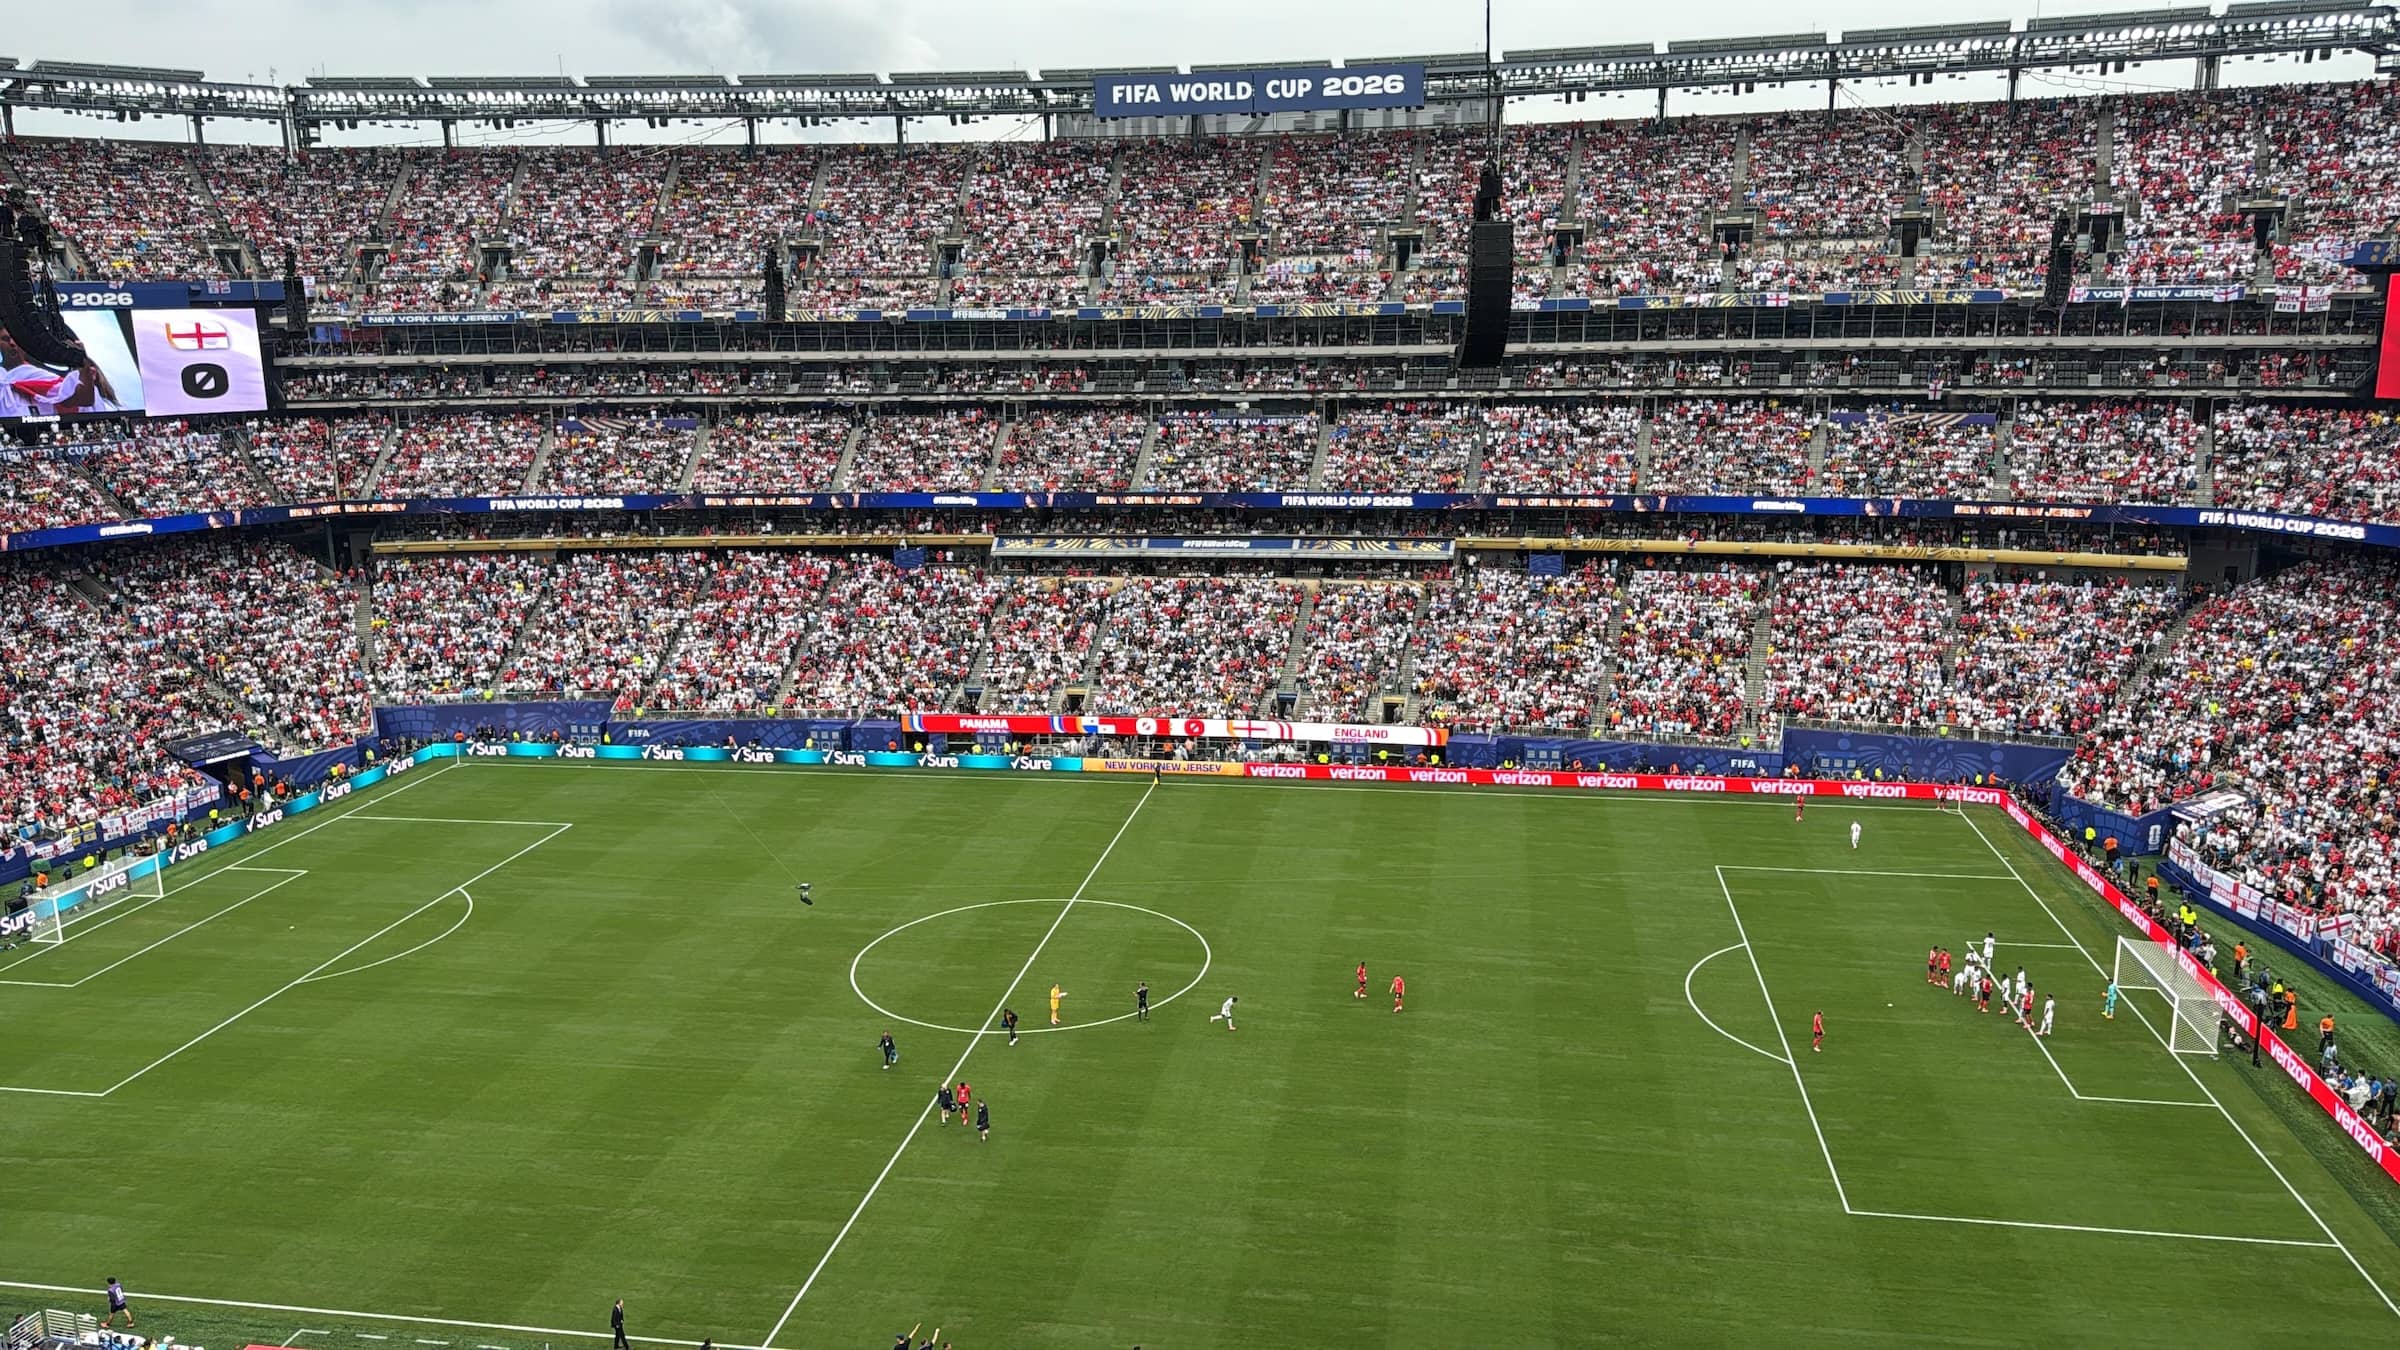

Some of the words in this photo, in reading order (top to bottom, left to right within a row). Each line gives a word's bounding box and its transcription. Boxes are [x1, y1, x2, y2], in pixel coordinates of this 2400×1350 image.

[1112, 84, 1161, 104] FIFA
[1169, 81, 1252, 102] WORLD
[1265, 78, 1313, 99] CUP
[1322, 74, 1405, 96] 2026
[71, 292, 134, 307] 2026
[2136, 289, 2171, 298] NEW
[2173, 288, 2214, 298] JERS
[368, 316, 395, 324] NEW
[398, 315, 430, 323] YORK
[432, 315, 460, 323] NEW
[462, 314, 508, 322] JERSEY
[181, 362, 229, 399] 0
[490, 500, 515, 510] FIFA
[516, 499, 558, 510] WORLD
[558, 498, 582, 509] CUP
[704, 497, 727, 506] NEW
[727, 497, 754, 506] YORK
[754, 497, 776, 506] NEW
[776, 497, 813, 506] JERSEY
[1096, 496, 1117, 505] NEW
[1118, 496, 1144, 505] YORK
[1144, 496, 1166, 505] NEW
[1166, 496, 1202, 505] JERSEY
[1281, 495, 1307, 506] FIFA
[1307, 495, 1348, 506] WORLD
[1348, 496, 1372, 507] CUP
[1496, 497, 1520, 507] NEW
[1521, 498, 1548, 507] YORK
[1549, 498, 1573, 507] NEW
[1573, 498, 1614, 508] JERSEY
[289, 508, 313, 517] NEW
[314, 505, 342, 515] YORK
[344, 504, 368, 513] NEW
[368, 502, 406, 512] JERSEY
[1953, 504, 1980, 515] NEW
[1982, 505, 2015, 516] YORK
[2015, 506, 2044, 517] NEW
[2044, 508, 2092, 519] JERSEY
[2199, 511, 2235, 525] FIFA
[2236, 513, 2284, 530] WORLD
[2285, 519, 2314, 534] CUP
[959, 718, 1009, 730] PANAMA
[628, 728, 650, 738] FIFA
[1334, 727, 1388, 739] ENGLAND
[476, 742, 507, 757] Sure
[560, 743, 596, 758] Sure
[653, 745, 684, 761] Sure
[743, 747, 774, 763] Sure
[834, 749, 865, 765] Sure
[393, 757, 415, 775] Sure
[927, 754, 958, 768] Sure
[1020, 756, 1052, 770] Sure
[1105, 760, 1127, 770] NEW
[1130, 761, 1157, 771] YORK
[1159, 762, 1180, 772] NEW
[1184, 763, 1221, 773] JERSEY
[1730, 758, 1756, 769] FIFA
[1249, 763, 1306, 778] verizon
[1329, 765, 1386, 781] verizon
[1409, 767, 1467, 783] verizon
[1493, 771, 1551, 786] verizon
[1577, 773, 1637, 789] verizon
[1663, 777, 1725, 792] verizon
[1751, 779, 1814, 795] verizon
[1842, 781, 1906, 797] verizon
[327, 782, 351, 801] Sure
[1934, 786, 2000, 804] verizon
[256, 809, 283, 829] Sure
[2007, 800, 2029, 831] verizon
[178, 839, 208, 861] Sure
[2041, 830, 2064, 861] verizon
[95, 872, 127, 896] Sure
[2076, 862, 2104, 896] verizon
[0, 910, 36, 936] Sure
[2119, 898, 2150, 935] verizon
[2166, 938, 2198, 981] veizon
[2214, 986, 2250, 1032] verizon
[2270, 1038, 2311, 1092] verizon
[2335, 1102, 2383, 1163] verizon
